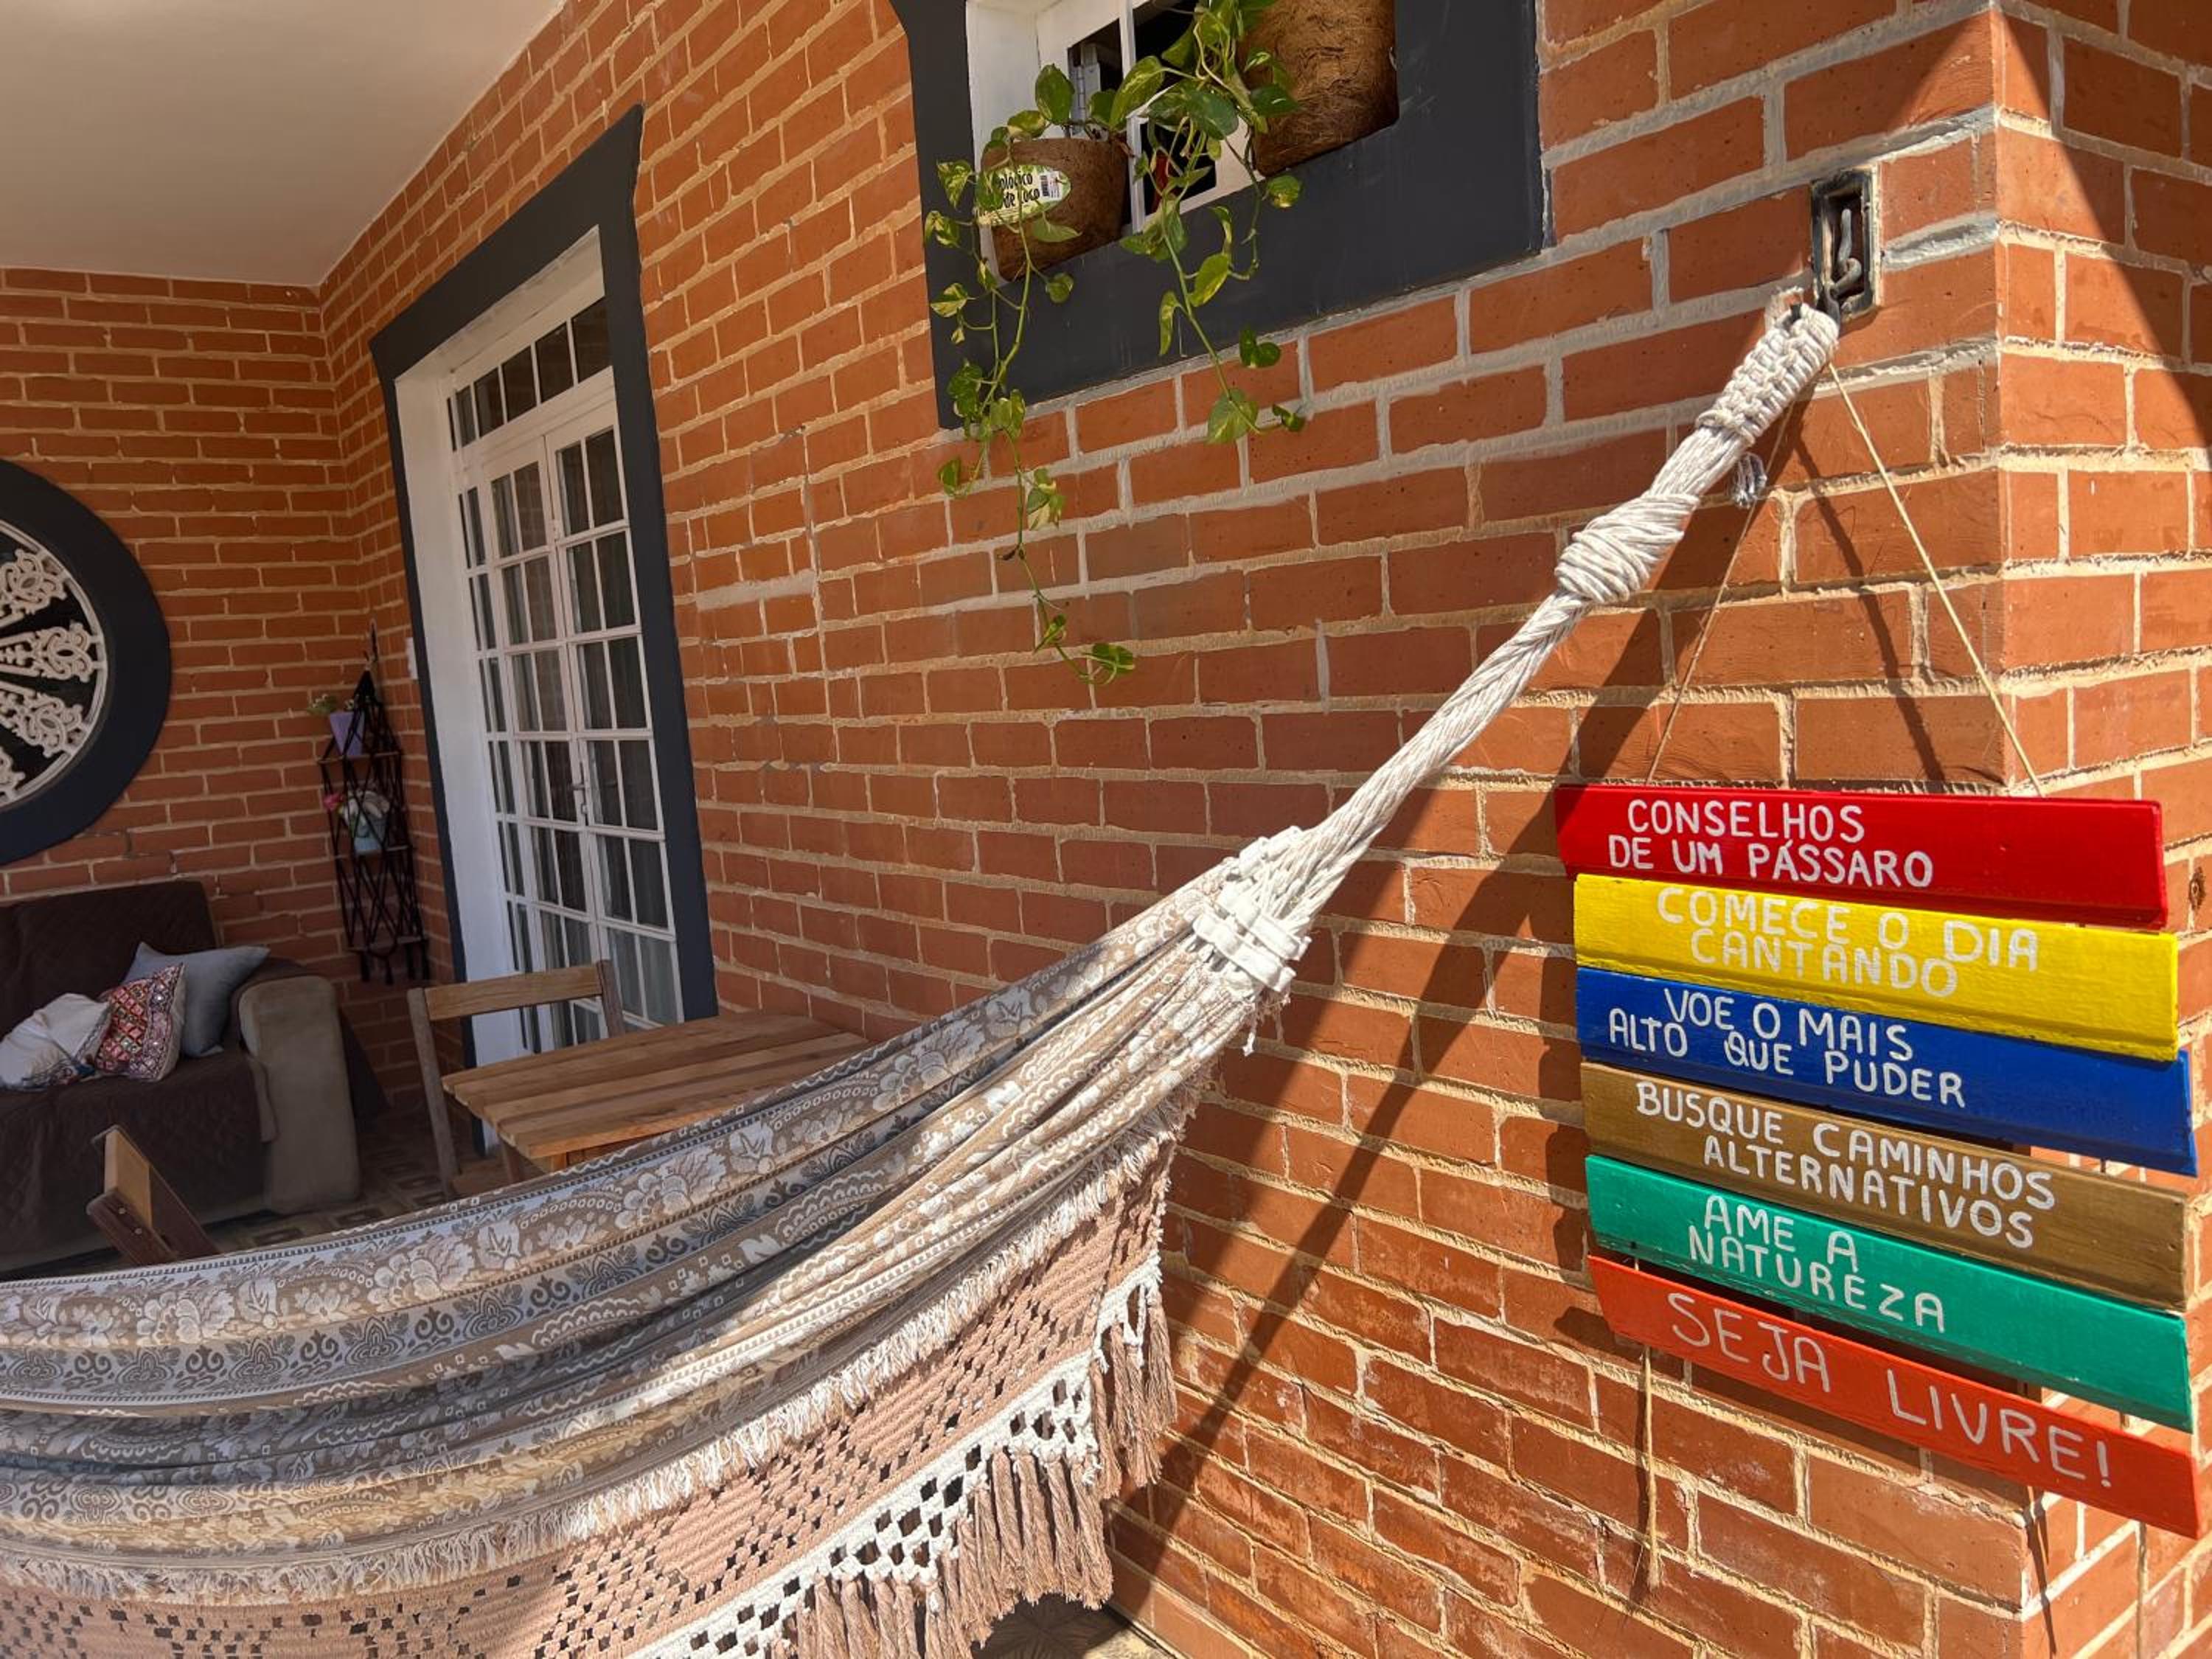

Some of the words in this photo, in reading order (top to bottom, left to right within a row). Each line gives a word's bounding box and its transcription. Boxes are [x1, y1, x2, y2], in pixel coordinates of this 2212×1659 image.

[1609, 835, 1653, 870] DE
[1672, 841, 1722, 874] UM
[1750, 840, 1934, 888] PÁSSARO
[1628, 799, 1864, 843] CONSELHOS
[1658, 888, 1850, 944] COMECE
[1878, 912, 1909, 950] O
[1944, 921, 2038, 971] DIA
[1691, 928, 1958, 997] CANTANDO
[1609, 1008, 1688, 1057] ALTO
[1724, 1032, 1793, 1076] QUE
[1826, 1051, 1965, 1107] PUDER
[1664, 988, 1735, 1031] VOE
[1753, 1001, 1781, 1040] O
[1799, 1009, 1913, 1060] MAIS
[1636, 1082, 1784, 1144] BUSQUE
[1812, 1122, 2055, 1210] CAMINHOS
[1704, 1135, 2034, 1248] ALTERNATIVOS
[1705, 1195, 1795, 1252] AME
[1827, 1231, 1858, 1273] A
[1689, 1225, 1945, 1332] NATUREZA
[1668, 1293, 1830, 1393] SEJA
[1886, 1369, 2112, 1488] LIVRE!
